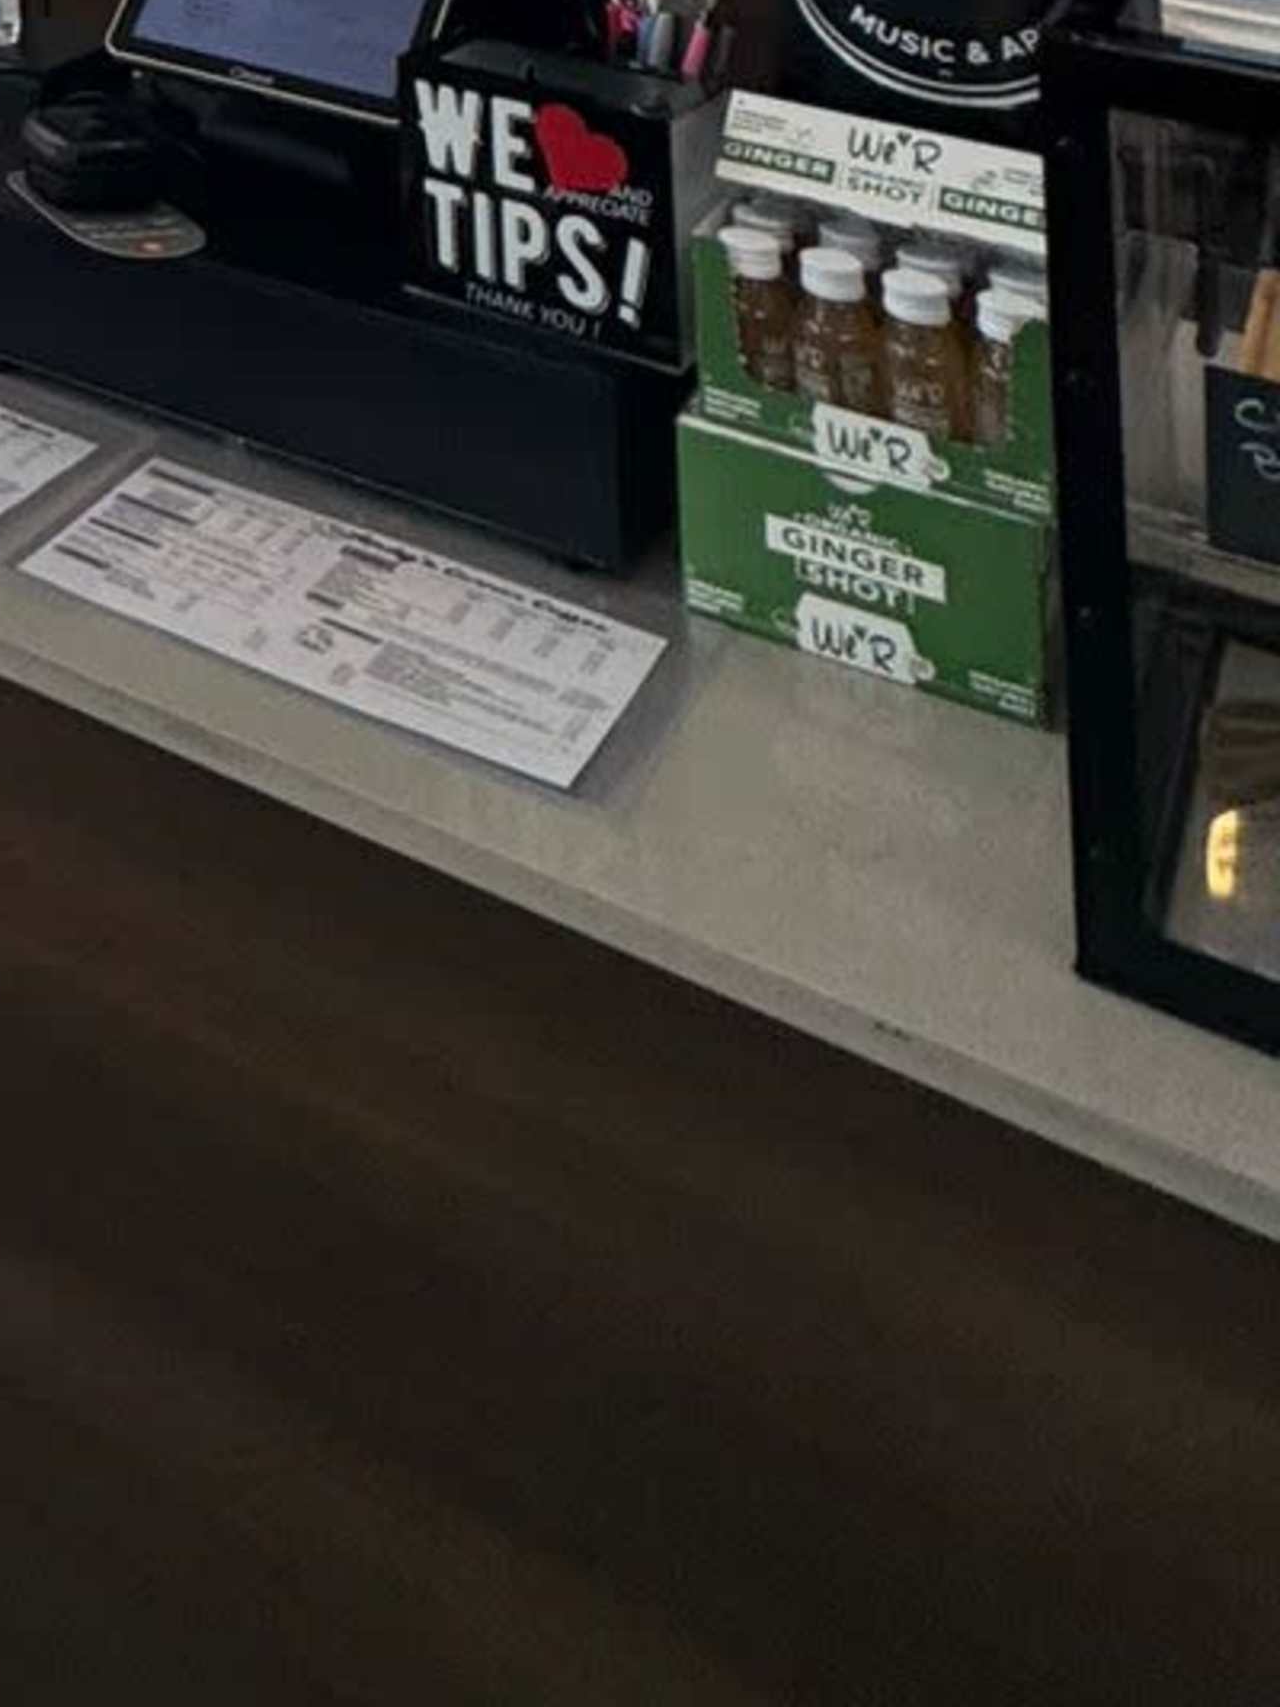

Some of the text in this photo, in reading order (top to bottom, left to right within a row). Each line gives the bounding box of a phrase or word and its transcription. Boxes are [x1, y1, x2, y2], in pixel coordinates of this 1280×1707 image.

[849, 3, 958, 64] MUSIC
[966, 39, 991, 65] &
[413, 78, 536, 194] WE
[723, 140, 831, 178] GINGER
[424, 177, 650, 331] TIPS!
[781, 527, 924, 585] GINGER
